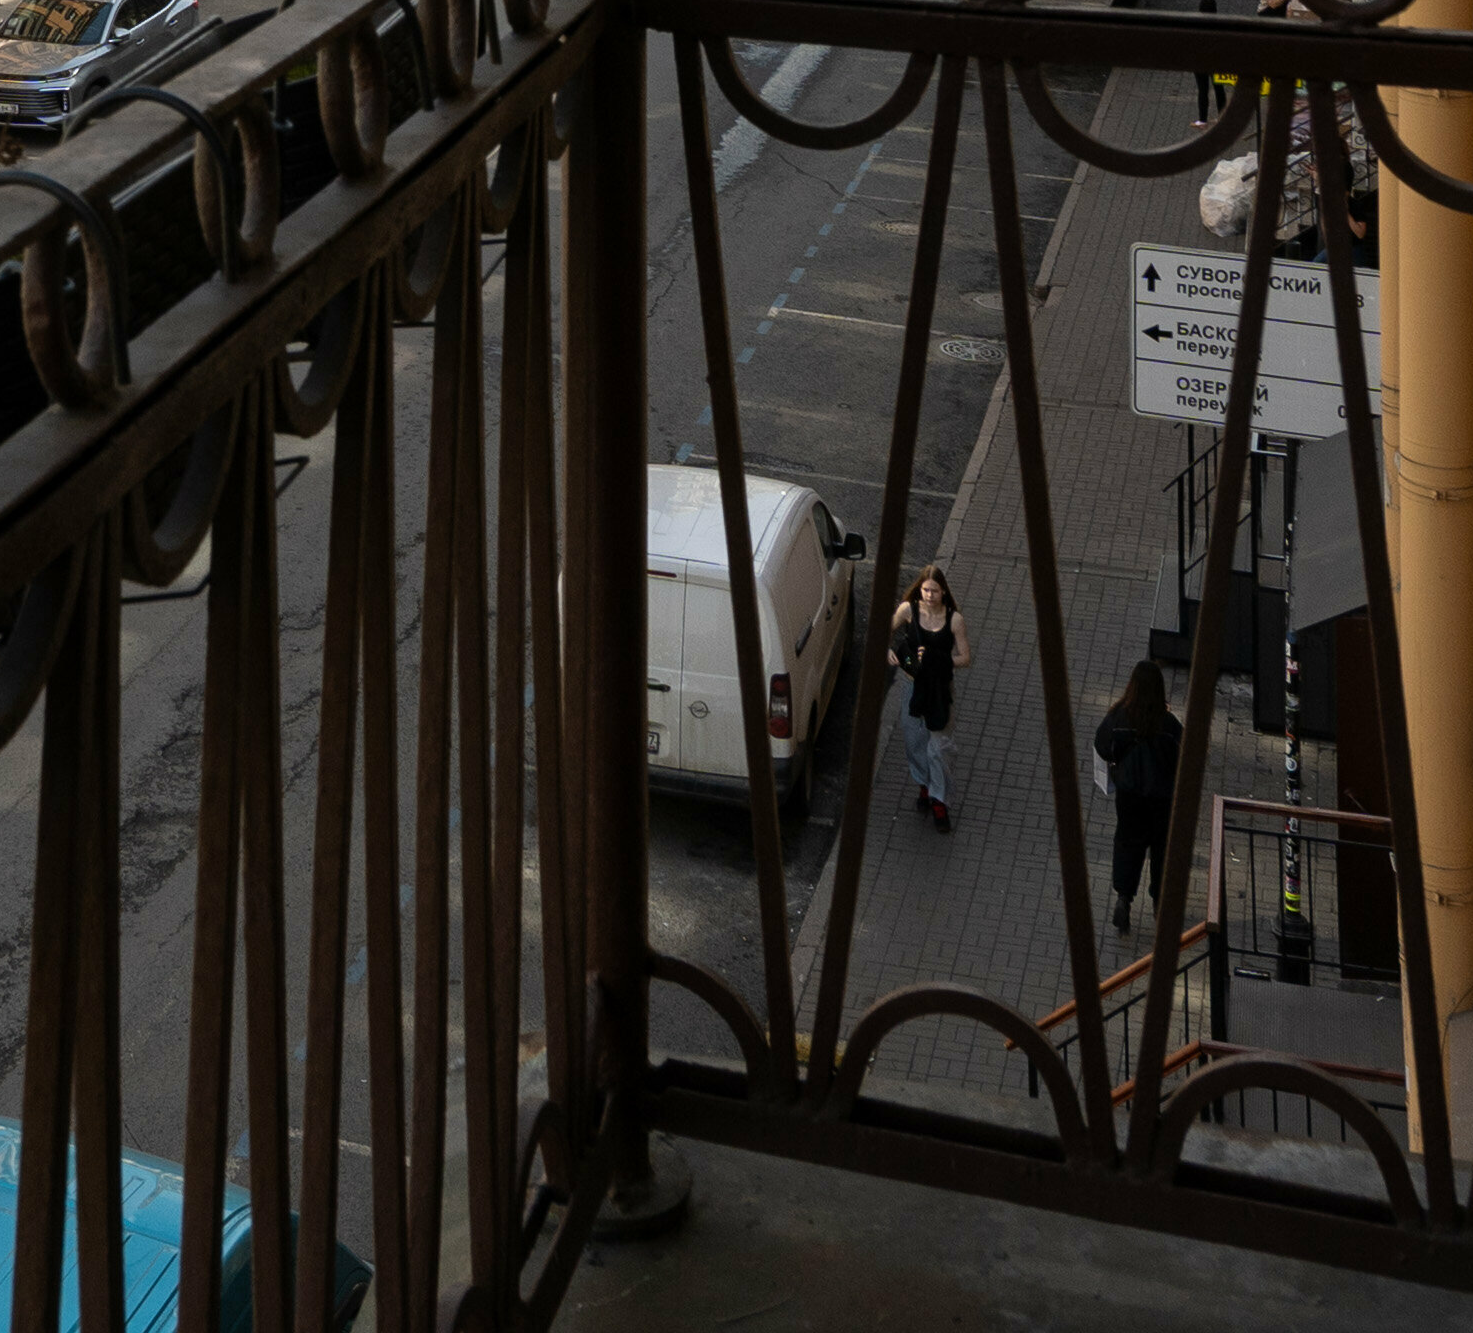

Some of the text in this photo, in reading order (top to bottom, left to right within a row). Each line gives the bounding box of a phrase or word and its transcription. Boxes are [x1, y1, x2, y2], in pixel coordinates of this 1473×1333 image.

[1177, 264, 1322, 295] СУВОРСКИЙ
[1177, 282, 1243, 301] проспе
[1177, 321, 1238, 343] БАСКО
[1177, 340, 1263, 362] переу
[1177, 376, 1269, 402] ОЗЕРЙ
[1177, 396, 1263, 417] переук
